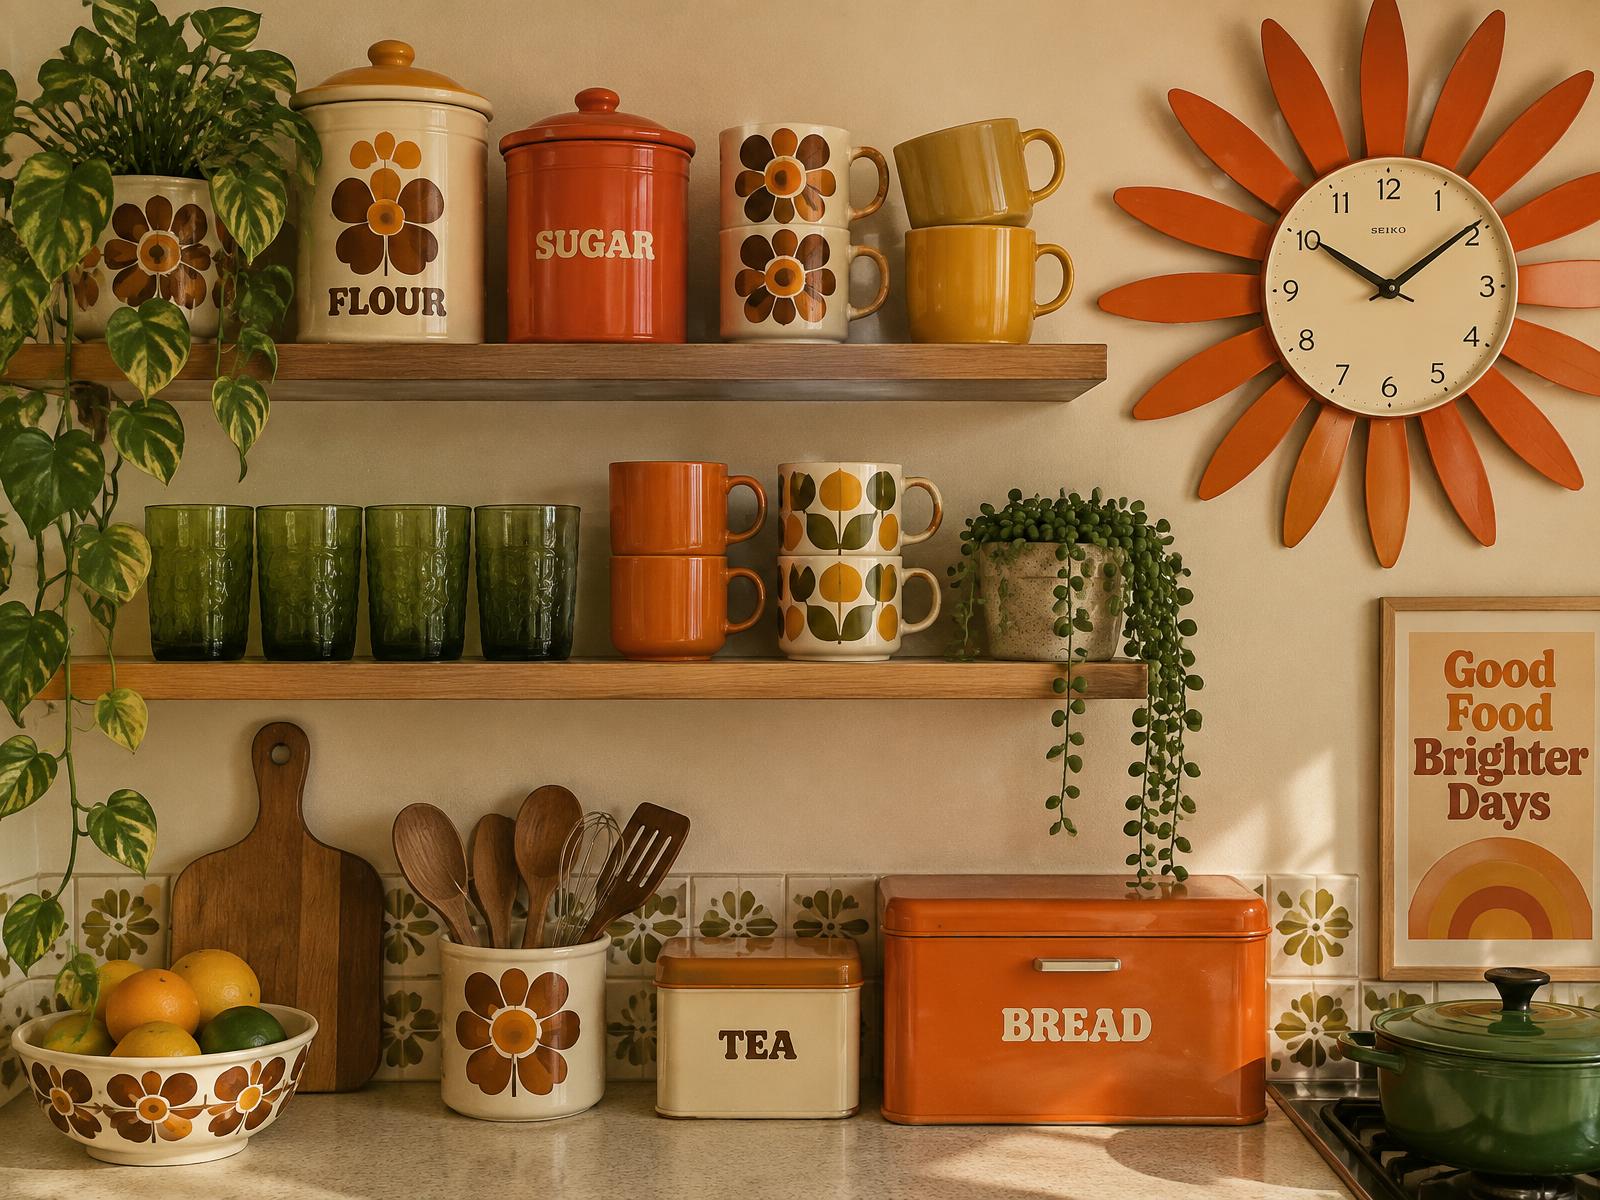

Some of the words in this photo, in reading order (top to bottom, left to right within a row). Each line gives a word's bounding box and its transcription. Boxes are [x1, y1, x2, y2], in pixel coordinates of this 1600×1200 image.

[1376, 178, 1401, 200] 12
[1434, 189, 1441, 212] 1
[1332, 191, 1349, 213] 11
[1296, 229, 1321, 251] 10
[1371, 226, 1406, 235] SEIKO
[1464, 224, 1480, 246] 2
[535, 228, 655, 260] SUGAR
[1282, 280, 1299, 302] 9
[1479, 275, 1495, 298] 3
[328, 285, 447, 317] FLOUR
[1298, 328, 1315, 351] 8
[1462, 326, 1480, 347] 4
[1335, 363, 1350, 386] 7
[1430, 362, 1445, 384] 5
[1381, 376, 1398, 398] 6
[1444, 648, 1556, 689] Good
[1446, 692, 1554, 732] Food
[1413, 736, 1589, 787] Brighter
[1447, 782, 1551, 831] Days
[1001, 1007, 1152, 1043] BREAD
[718, 1029, 798, 1060] TEA
